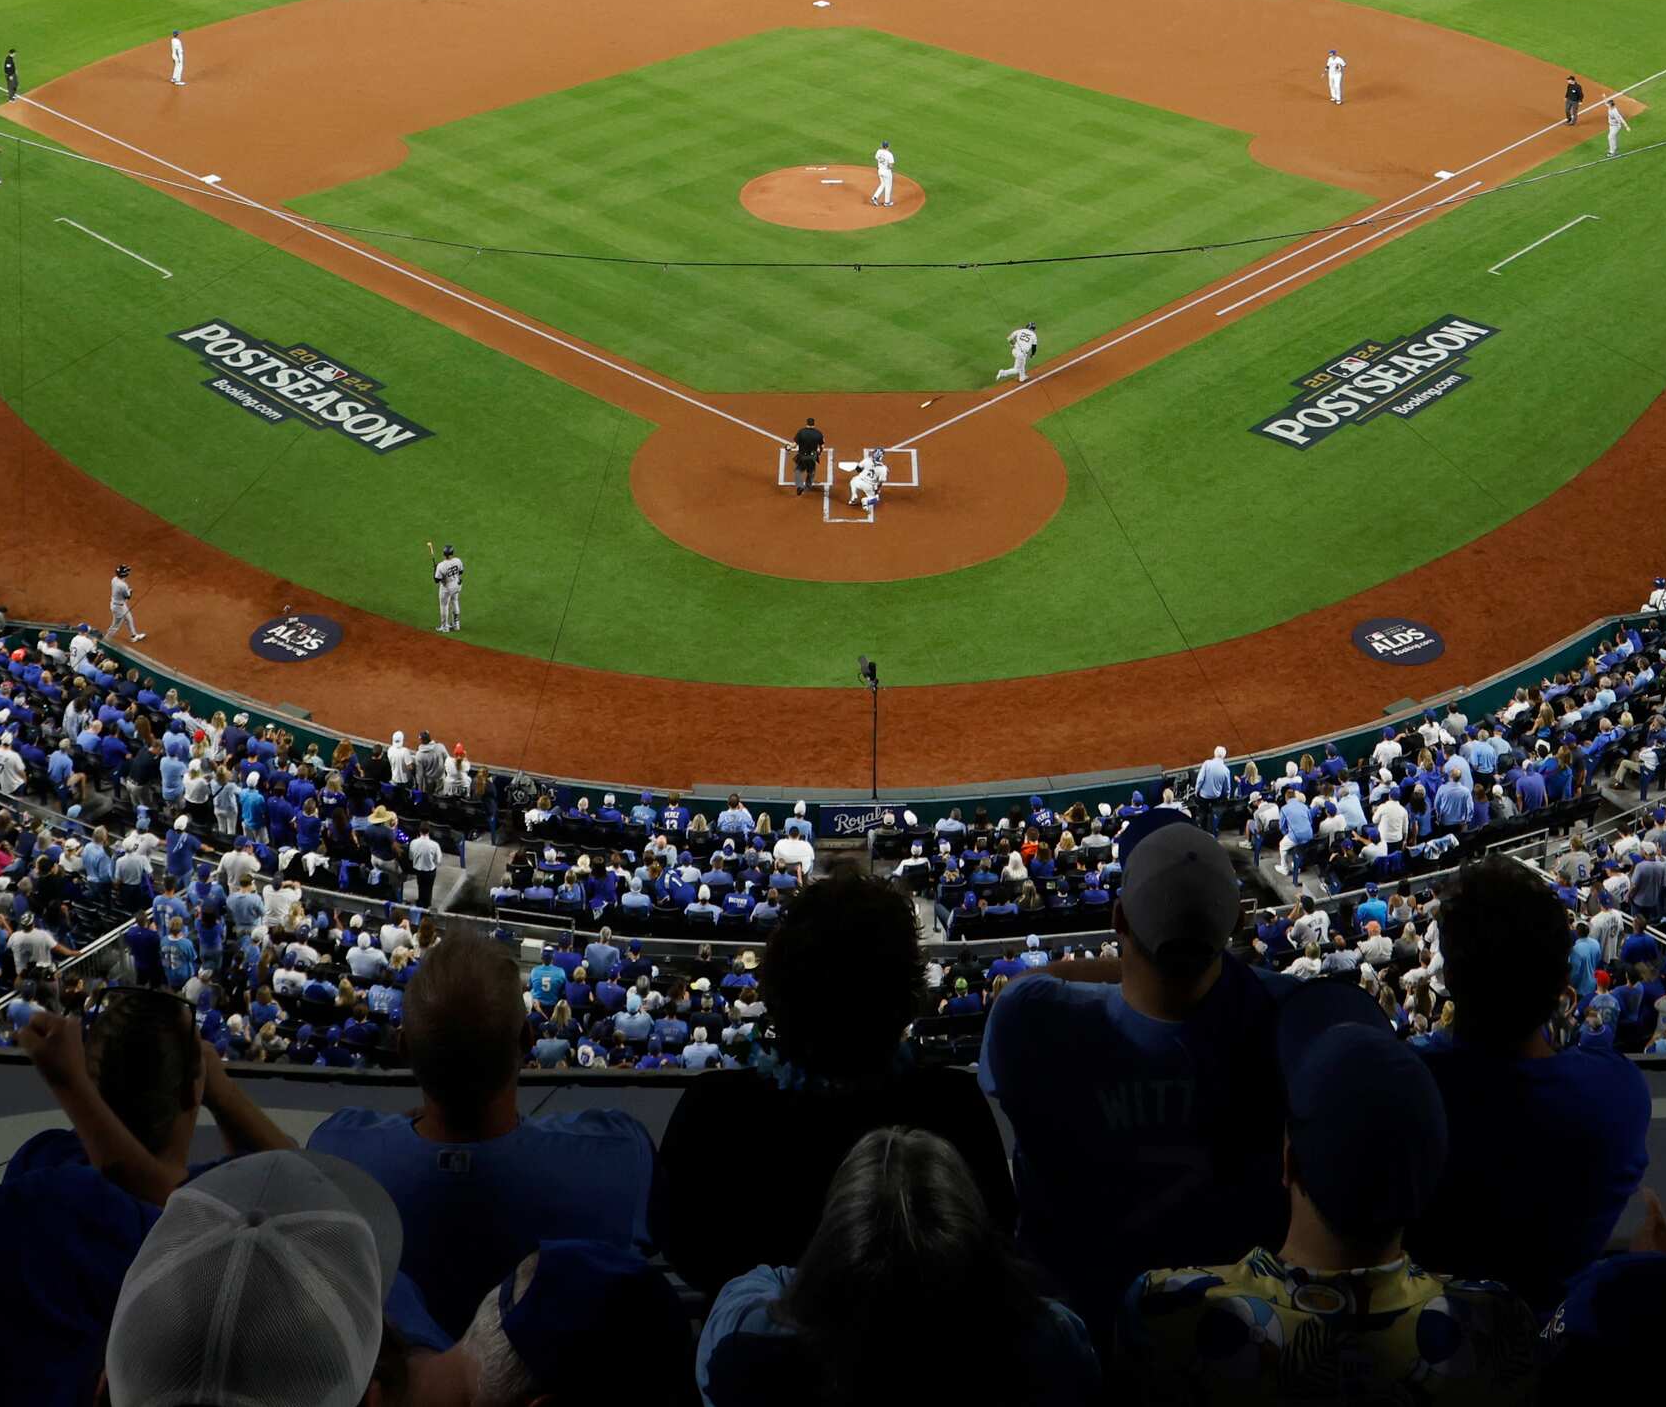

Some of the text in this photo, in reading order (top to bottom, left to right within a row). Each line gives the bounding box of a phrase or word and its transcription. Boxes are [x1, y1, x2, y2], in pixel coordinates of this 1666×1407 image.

[289, 348, 374, 392] 20 24
[1262, 320, 1490, 444] POSTSEASON
[1303, 344, 1382, 389] 20 24
[178, 324, 416, 449] POSTSEASON
[211, 379, 283, 420] Booking.com
[1392, 374, 1462, 415] Booking.com
[448, 565, 458, 577] 22
[267, 624, 324, 650] ALDS
[1370, 628, 1426, 654] ALDS
[665, 819, 679, 830] 13
[834, 806, 889, 832] Royals
[1578, 864, 1586, 878] 6
[542, 977, 551, 991] 5
[1093, 1078, 1197, 1132] WITT
